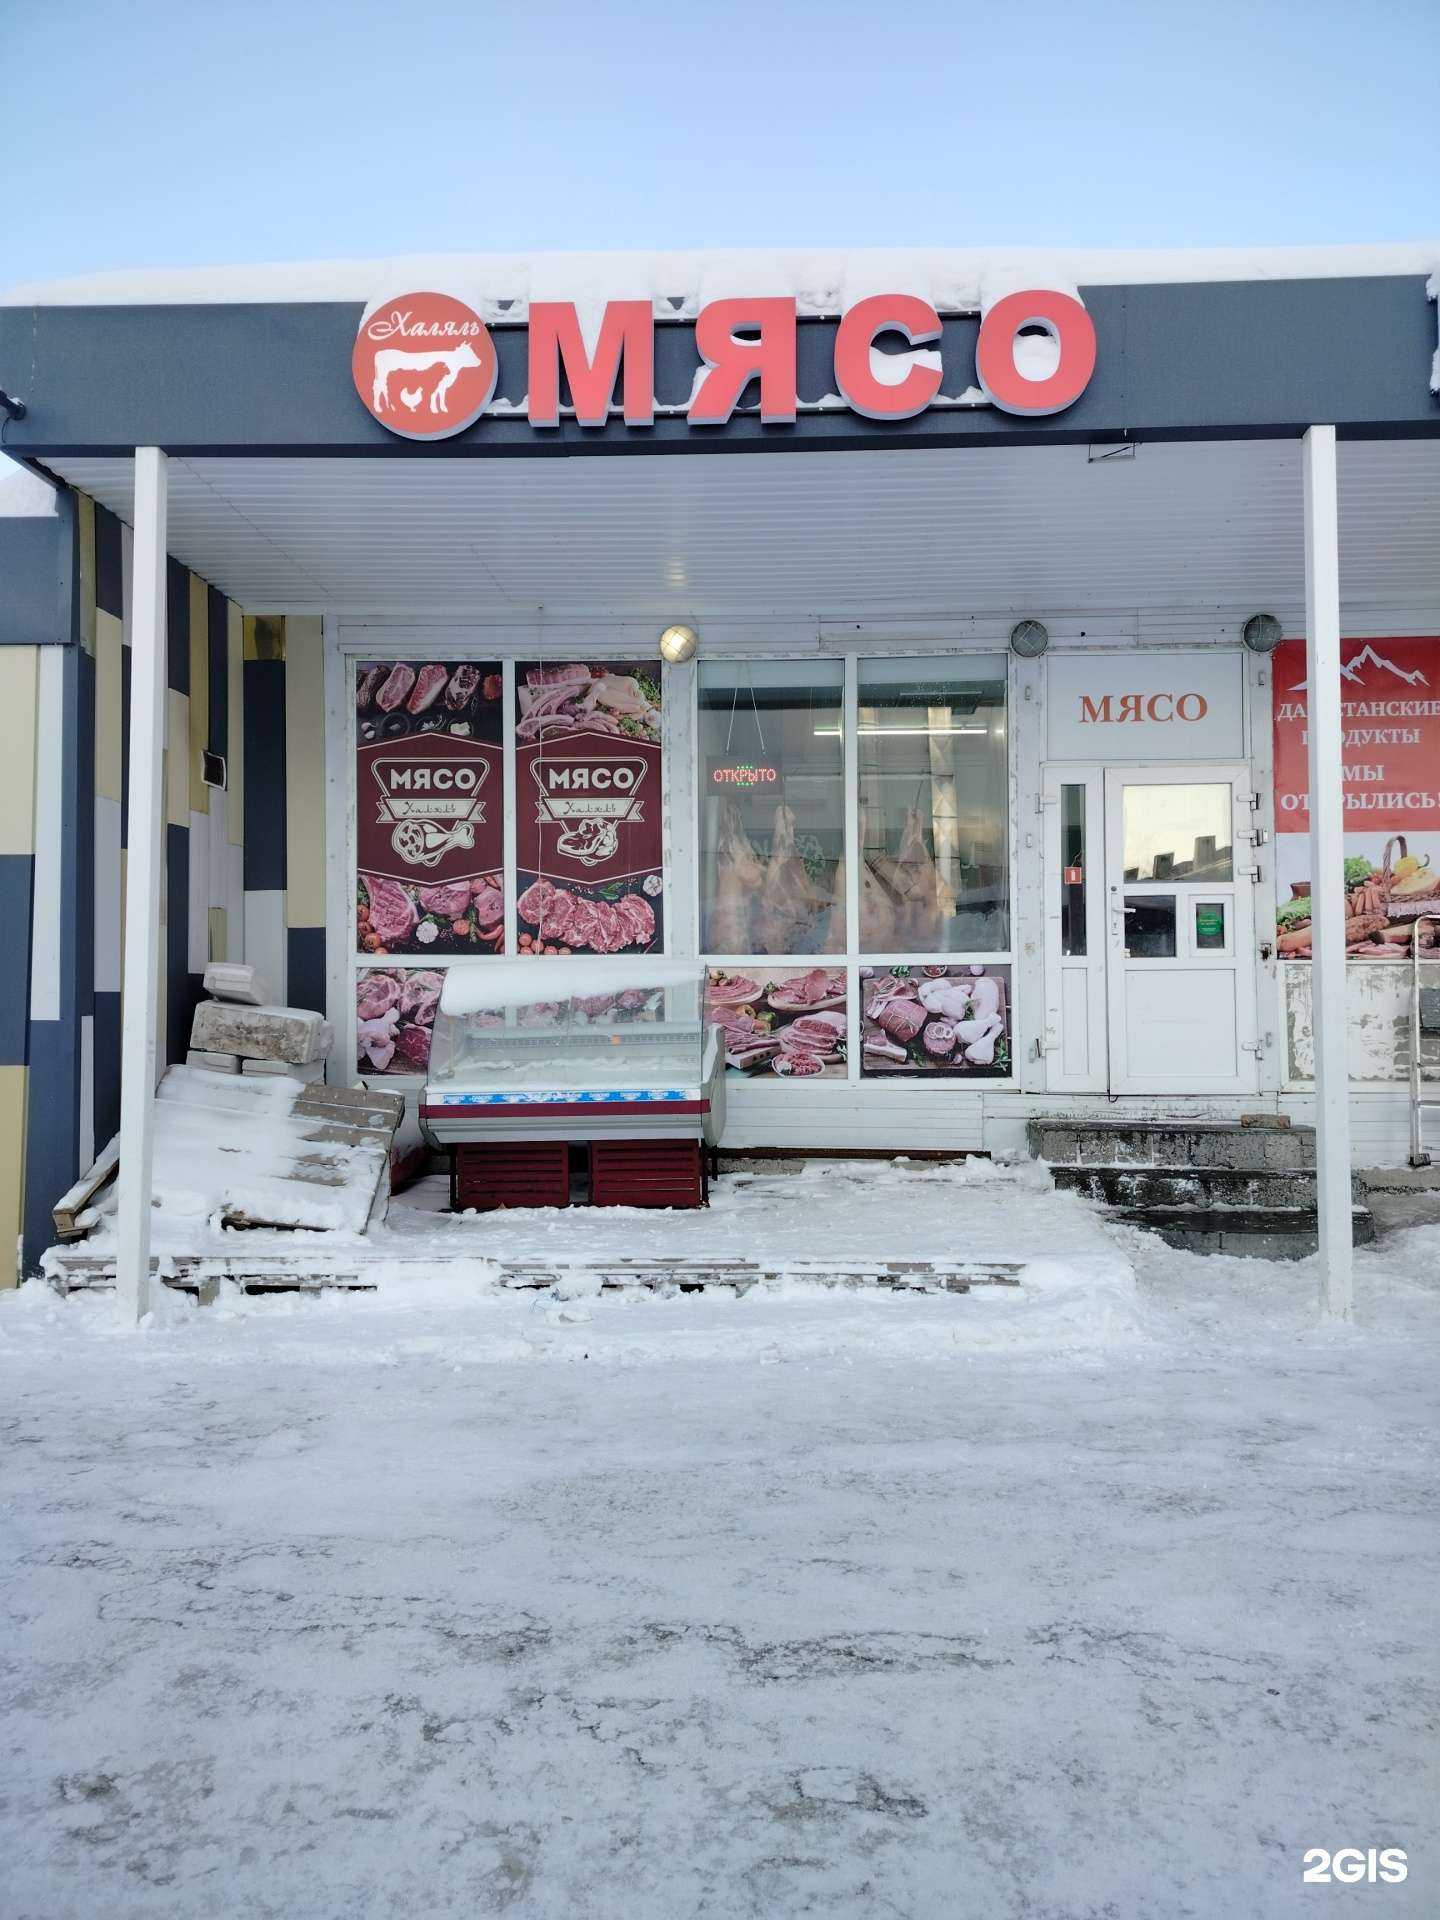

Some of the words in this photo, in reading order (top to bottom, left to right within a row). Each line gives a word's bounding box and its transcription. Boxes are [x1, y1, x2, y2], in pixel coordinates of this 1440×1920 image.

[367, 310, 480, 340] Халяль
[528, 290, 1097, 428] МЯСО
[1079, 693, 1208, 723] МЯСО
[1278, 700, 1440, 721] ДАТАНСКИЕ
[1302, 728, 1421, 748] ДУКТЫ
[390, 768, 477, 789] МЯСО
[549, 768, 635, 789] МЯСО
[713, 768, 777, 783] ОТКРЫТО
[1341, 765, 1385, 781] МЫ
